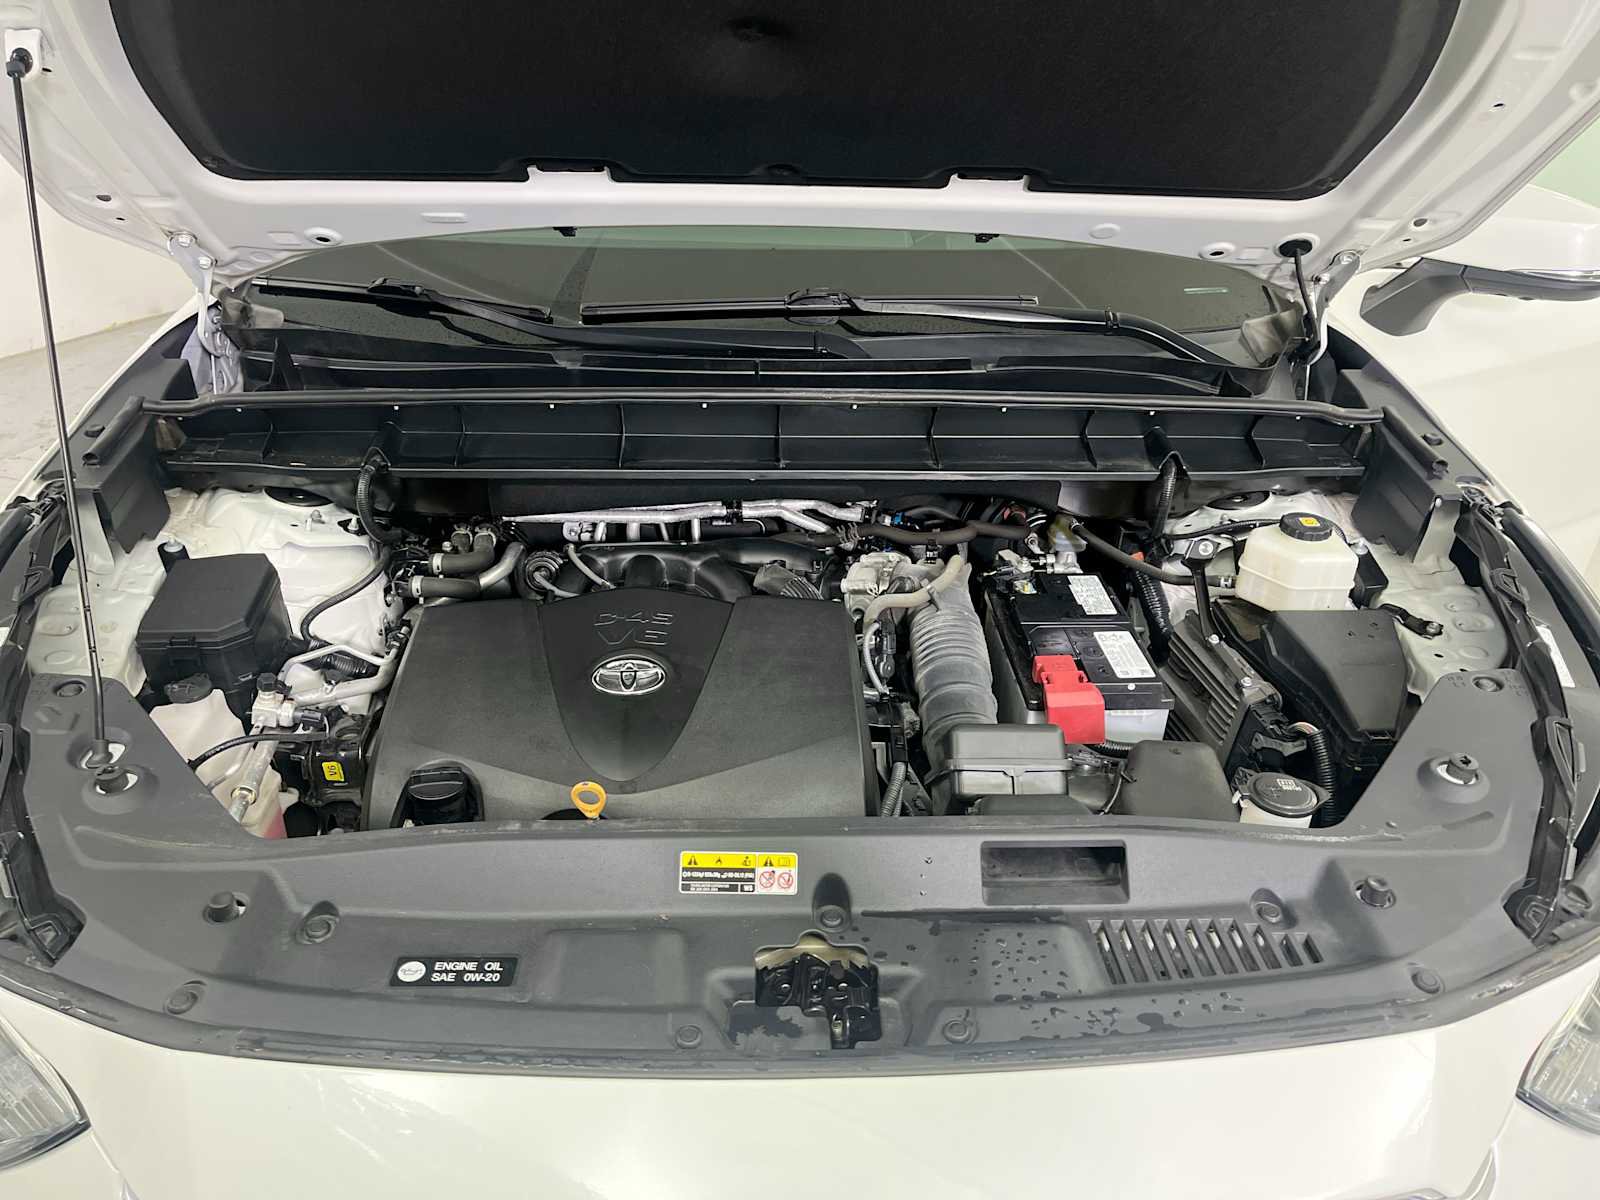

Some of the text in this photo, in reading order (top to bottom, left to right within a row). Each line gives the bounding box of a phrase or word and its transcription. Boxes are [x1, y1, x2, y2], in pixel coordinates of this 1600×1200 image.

[434, 962, 504, 971] ENGINE OIL
[431, 973, 501, 982] SAE 0W-20
